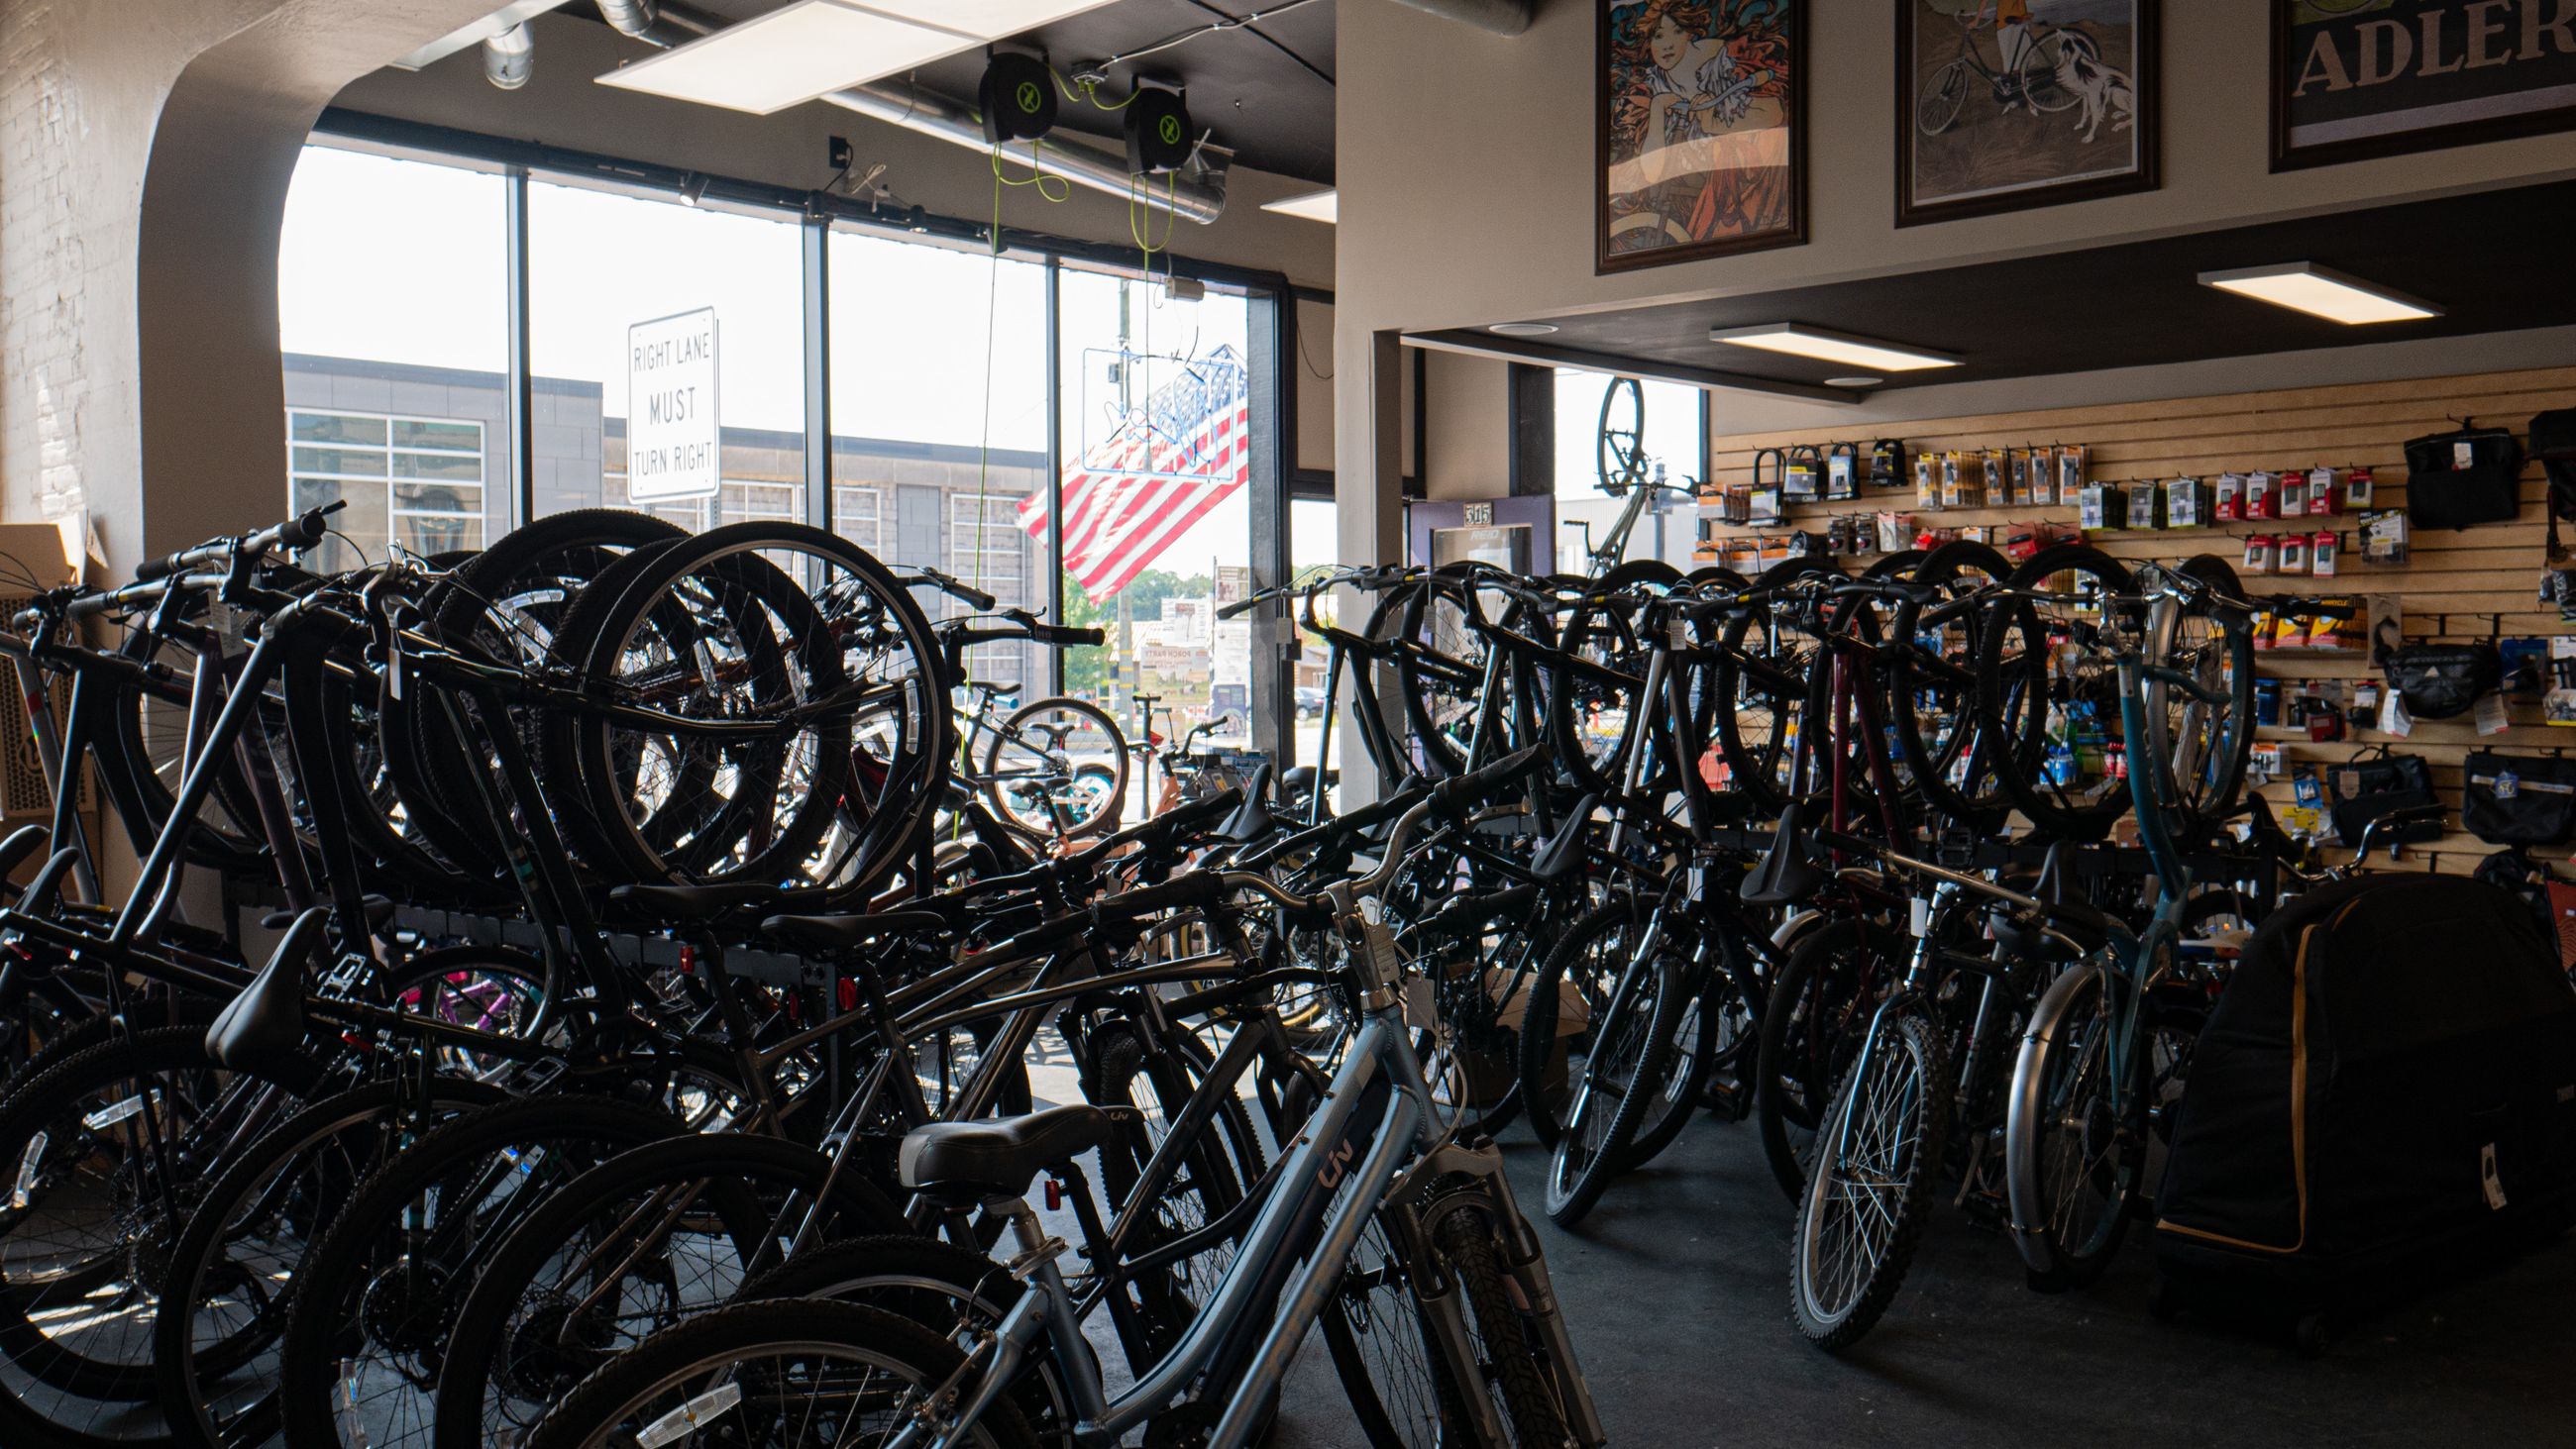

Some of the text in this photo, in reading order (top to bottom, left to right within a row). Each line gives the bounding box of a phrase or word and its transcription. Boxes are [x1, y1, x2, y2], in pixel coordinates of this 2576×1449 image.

[2292, 0, 2576, 98] ADLER
[634, 333, 710, 372] RIGHT LANE
[650, 387, 696, 425] MUST
[634, 442, 712, 476] TURN RIGHT
[1466, 506, 1490, 523] 315
